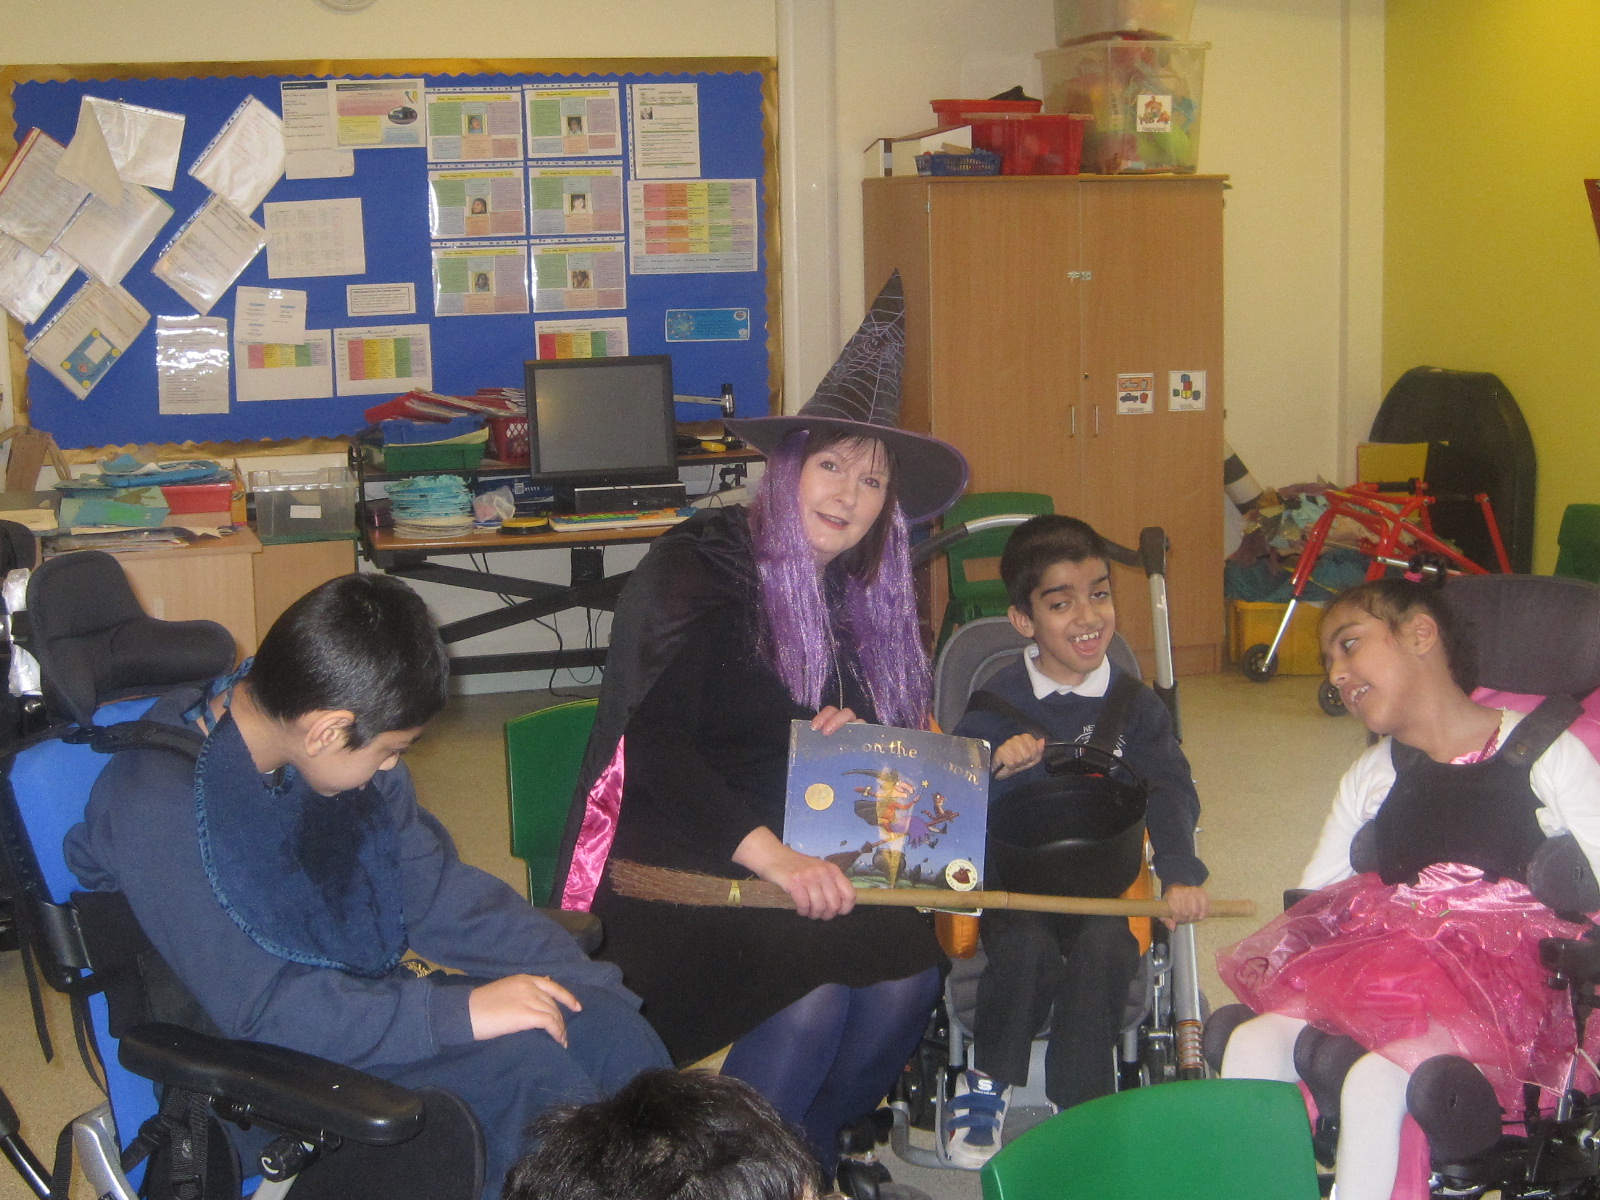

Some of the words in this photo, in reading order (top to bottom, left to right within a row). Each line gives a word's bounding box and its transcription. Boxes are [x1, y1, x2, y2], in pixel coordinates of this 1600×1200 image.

[1082, 724, 1096, 733] NE
[862, 742, 885, 754] on
[888, 740, 918, 759] the
